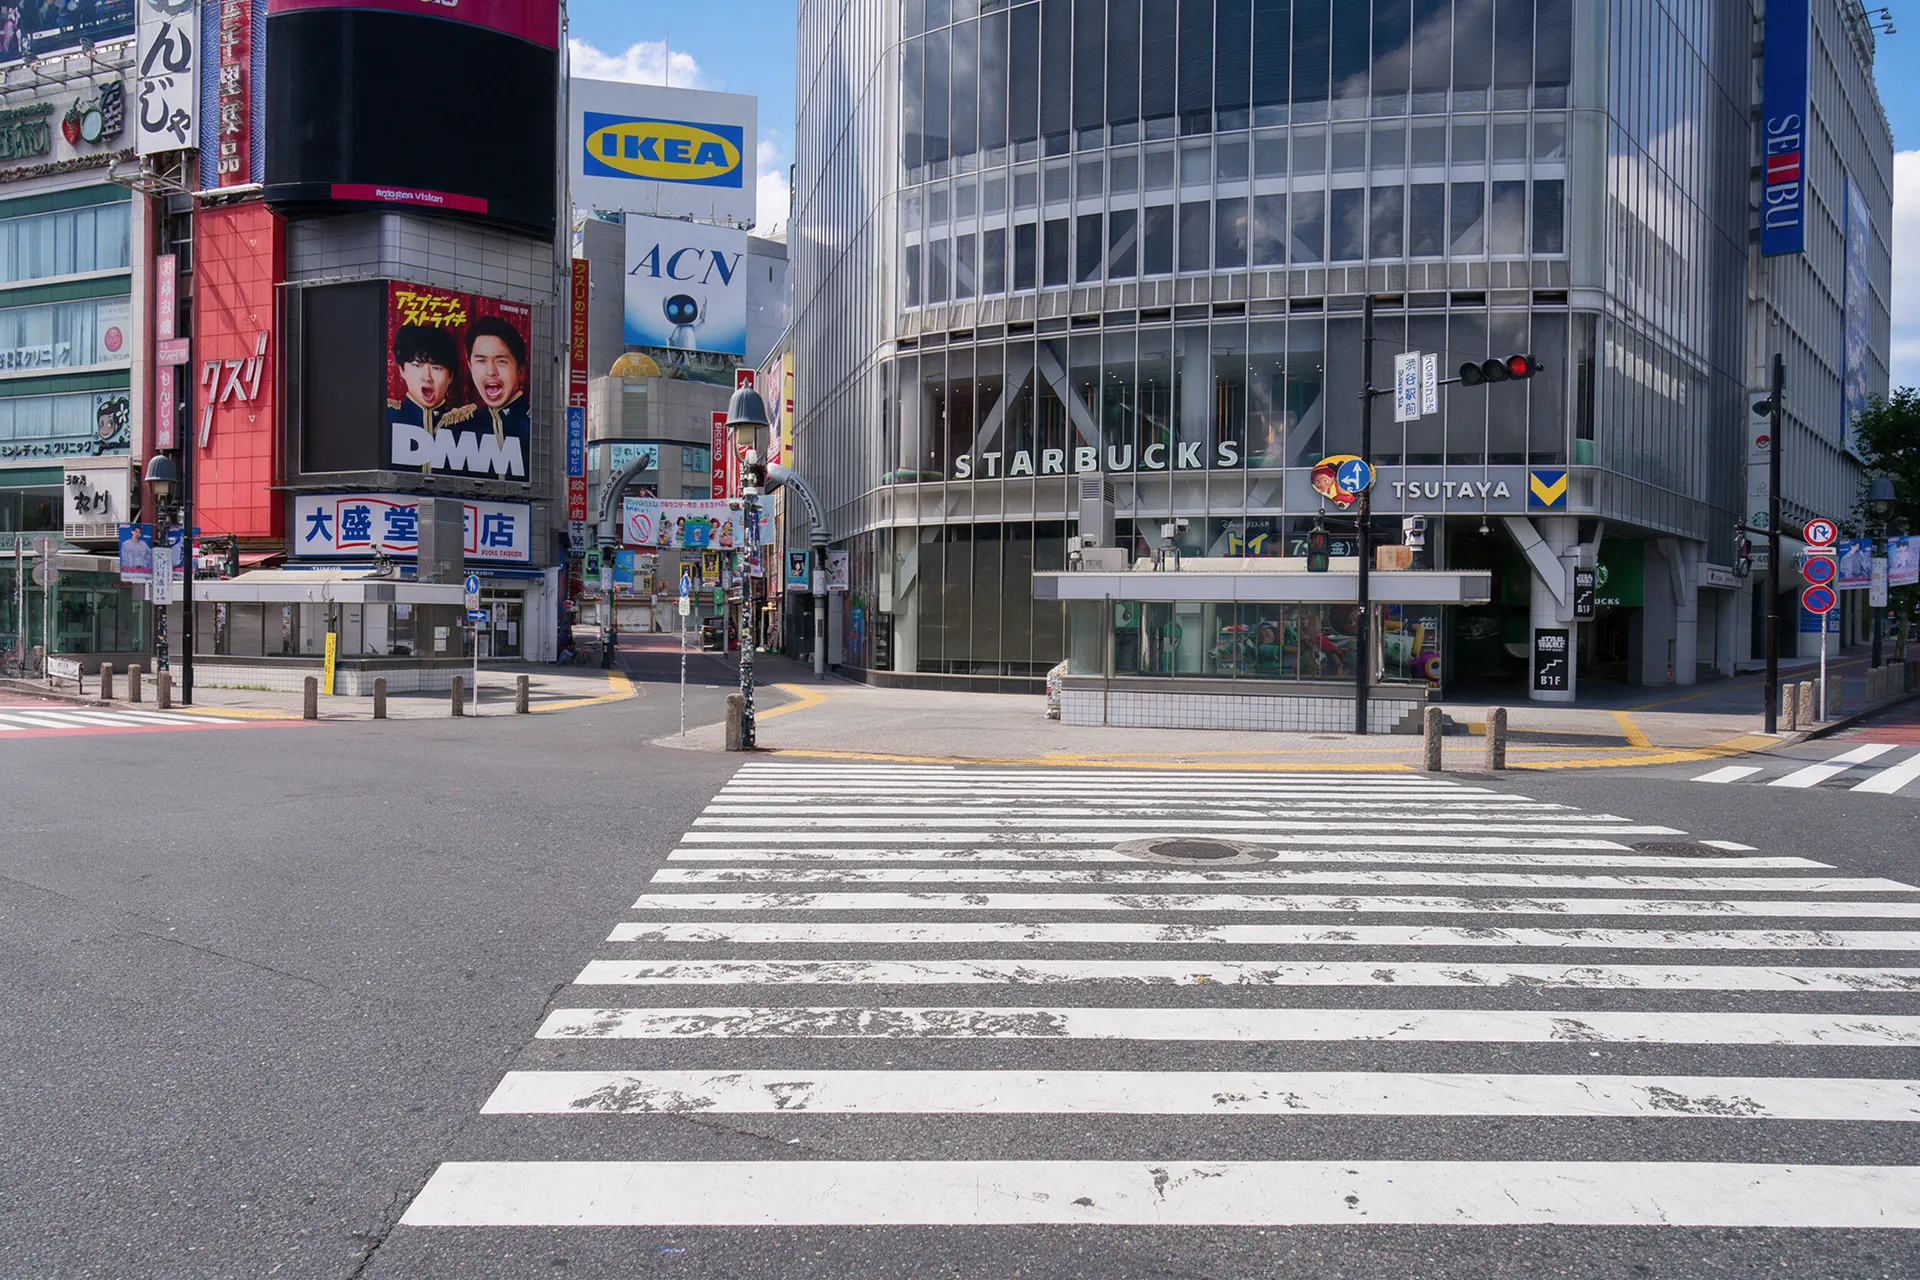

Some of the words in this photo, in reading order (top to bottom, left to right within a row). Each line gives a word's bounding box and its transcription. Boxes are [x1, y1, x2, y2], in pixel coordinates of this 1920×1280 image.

[602, 132, 729, 168] IKEA
[1766, 113, 1801, 231] SEIBU
[415, 192, 443, 203] Vision
[628, 243, 744, 287] ACN
[395, 290, 461, 313] アップデート
[402, 310, 467, 329] ストライキ
[574, 263, 586, 361] クスリのことなら
[198, 330, 268, 448] クスリ
[1405, 358, 1416, 416] 渋谷駅前
[391, 423, 525, 477] DMM
[955, 440, 1239, 478] STARBUCKS
[1392, 481, 1511, 499] TSUTAYA
[305, 505, 516, 548] 大盛堂店
[1577, 604, 1591, 613] B1F
[1540, 676, 1561, 685] B1F
